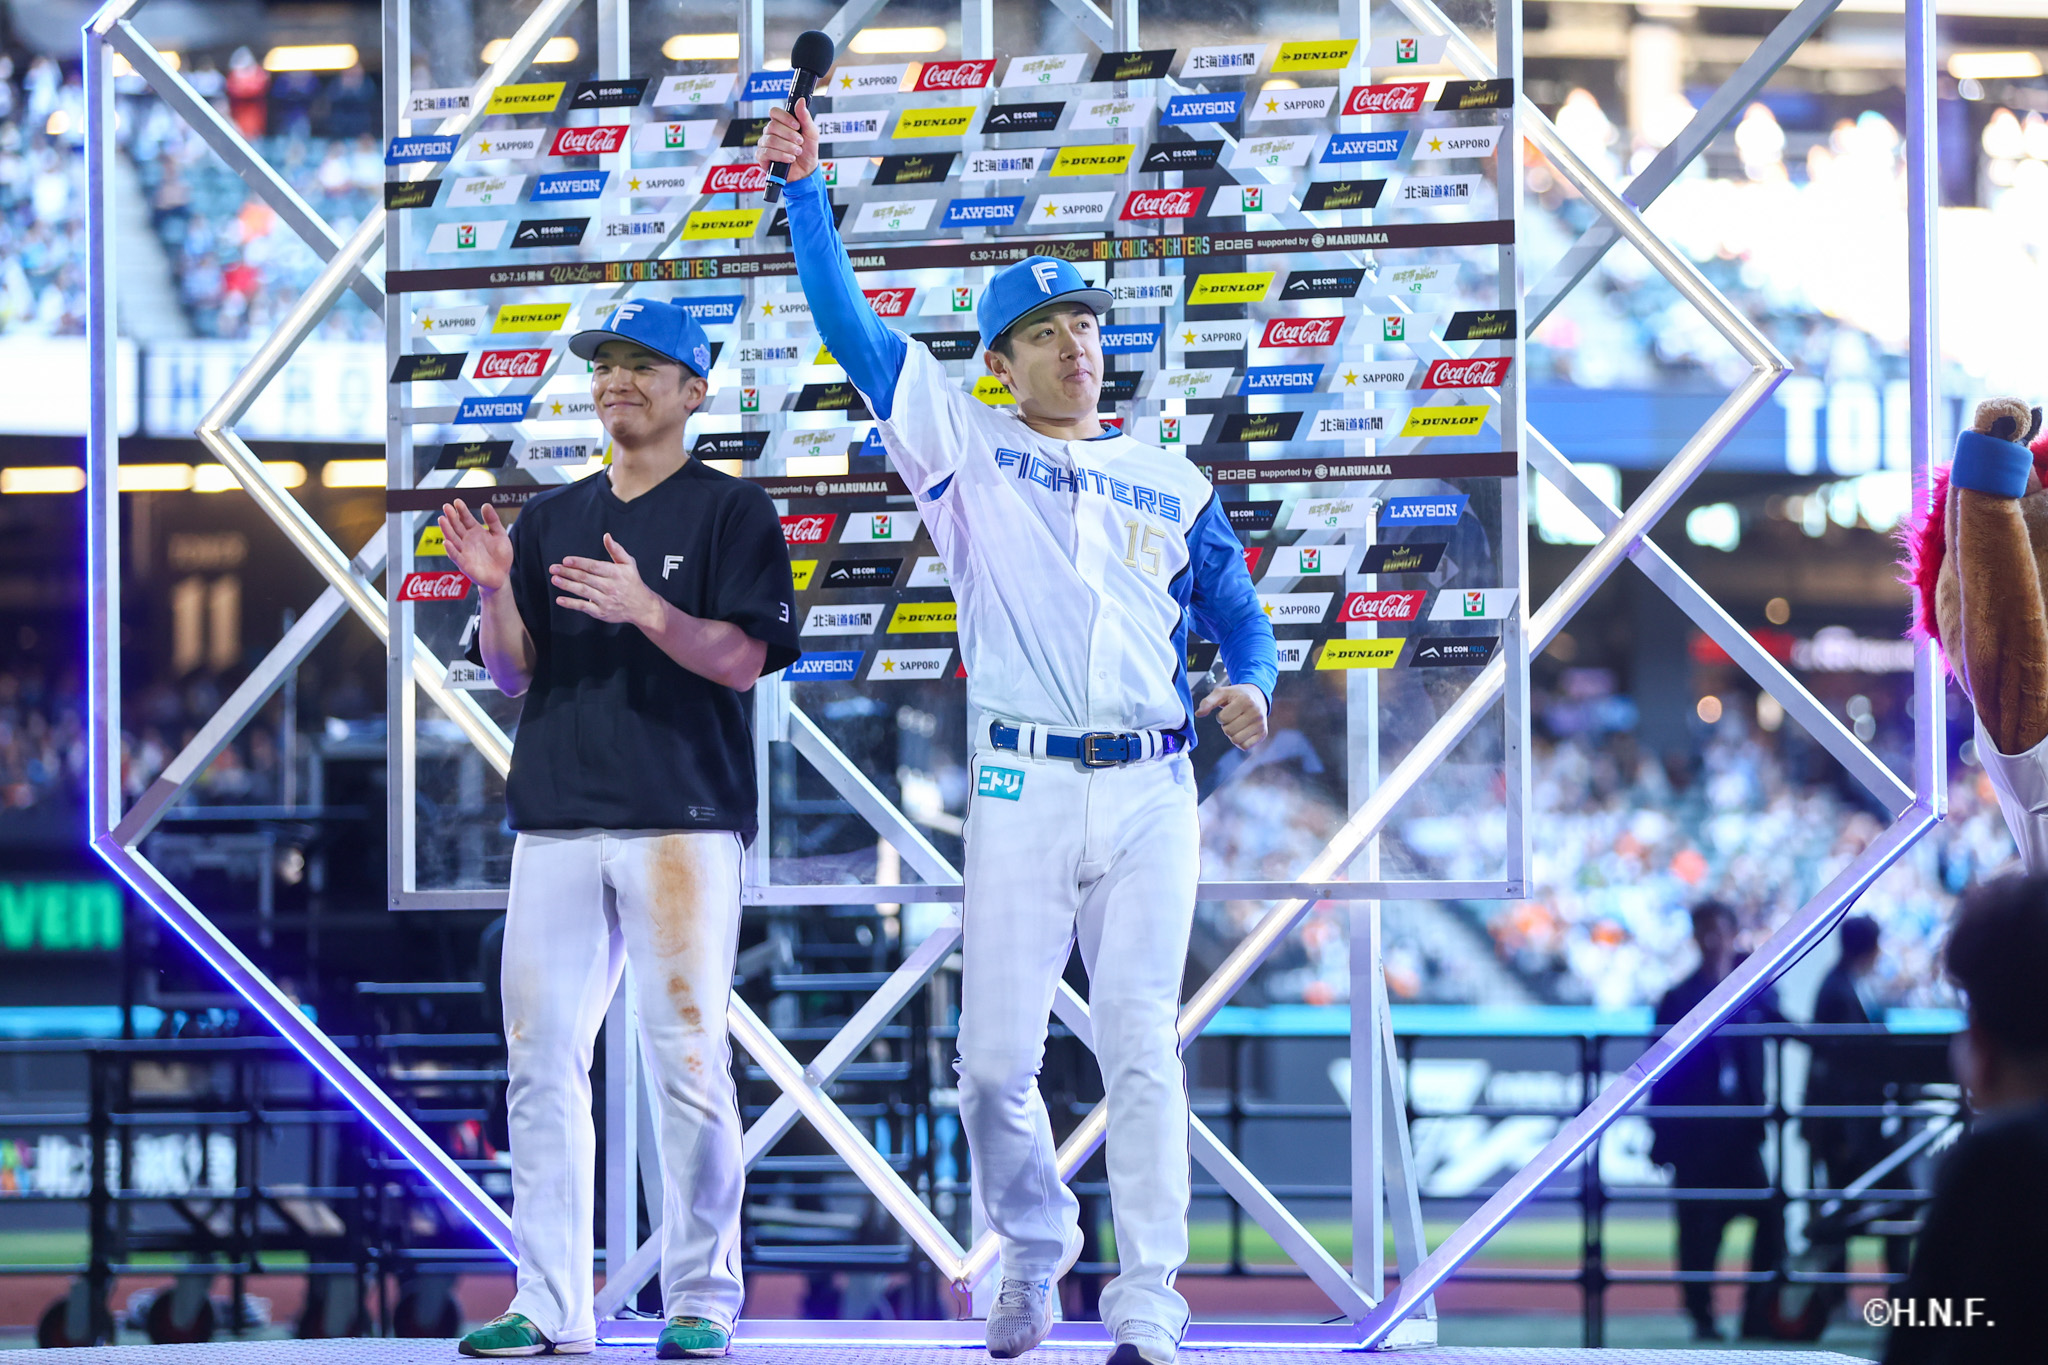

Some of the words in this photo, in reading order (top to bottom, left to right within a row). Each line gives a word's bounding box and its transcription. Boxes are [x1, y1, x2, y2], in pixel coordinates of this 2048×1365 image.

[1193, 52, 1255, 68] 北海道新聞
[1293, 50, 1348, 60] DUNLOP
[858, 76, 897, 86] SAPPORO
[923, 62, 983, 87] Coca-Cola
[751, 79, 794, 93] LAWS
[413, 93, 470, 111] 北海道新聞
[505, 93, 555, 104] DUNLOP
[1284, 100, 1325, 110] SAPPORO
[1353, 86, 1417, 112] Coca-Cola
[1171, 101, 1235, 116] LAWSON
[819, 121, 877, 134] 北海道新聞
[914, 117, 966, 127] DUNLOP
[496, 140, 533, 151] SAPPORO
[559, 128, 617, 152] Coca-Cola
[1332, 139, 1397, 154] LAWSON
[1448, 139, 1489, 149] SAPPORO
[393, 142, 451, 156] LAWSON
[973, 158, 1033, 172] 北海道新聞
[1071, 156, 1125, 165] DUNLOP
[540, 179, 600, 194] LAWSON
[646, 176, 685, 188] SAPPORO
[1405, 184, 1468, 199] 北海道新聞
[1063, 204, 1103, 214] SAPPORO
[1130, 192, 1192, 216] Coca-Cola
[951, 205, 1014, 220] LAWSON
[607, 222, 665, 236] 北海道新聞
[701, 221, 753, 229] DUNLOP
[970, 249, 1009, 261] 6.30-7.16
[1155, 236, 1211, 257] FIGHTERS
[1214, 239, 1254, 250] 2026
[1257, 237, 1297, 248] supported
[1299, 236, 1309, 247] by
[1326, 233, 1389, 246] MARUNAKA
[852, 256, 886, 267] UNAKA
[664, 259, 718, 279] FIGHTERS
[722, 262, 760, 274] 2026
[1030, 261, 1059, 295] F
[1210, 284, 1264, 293] DUNLOP
[779, 304, 810, 314] SAPPOR
[439, 318, 476, 328] SAPPORO
[511, 313, 561, 323] DUNLOP
[610, 303, 644, 331] F
[1100, 332, 1153, 346] AWSON
[1202, 332, 1241, 343] SAPPORO
[1269, 320, 1333, 344] Coca-Cola
[740, 347, 797, 362] 北海道新聞
[483, 352, 538, 375] Coca-Cola
[1249, 373, 1313, 387] LAWSON
[1363, 373, 1404, 383] SAPPORO
[1433, 361, 1496, 386] Coca-Cola
[463, 402, 523, 416] LAWSON
[568, 403, 596, 413] SAPPO
[1321, 418, 1382, 431] 北海道新聞
[1422, 417, 1478, 426] DUNLOP
[529, 445, 586, 460] 北海道新聞
[1218, 469, 1256, 480] 2026
[1260, 467, 1300, 478] supported
[1302, 467, 1313, 478] by
[1329, 464, 1392, 477] MARUNAKA
[803, 485, 813, 494] by
[829, 481, 888, 494] MARUNAKA
[994, 447, 1181, 523] FIGHTERS
[492, 493, 527, 504] 6.30-7.16
[1391, 504, 1457, 518] LAWSON
[1122, 519, 1167, 576] 15
[406, 575, 462, 598] Coca-Cola
[1280, 604, 1320, 615] SAPPORO
[1348, 593, 1413, 619] Coca-Cola
[813, 612, 871, 627] 北海道新聞
[1338, 649, 1393, 659] DUNLOP
[792, 659, 853, 674] LAWSON
[900, 660, 939, 670] SAPPORO
[453, 669, 492, 682] 北海道
[980, 769, 1021, 794] ニトリ
